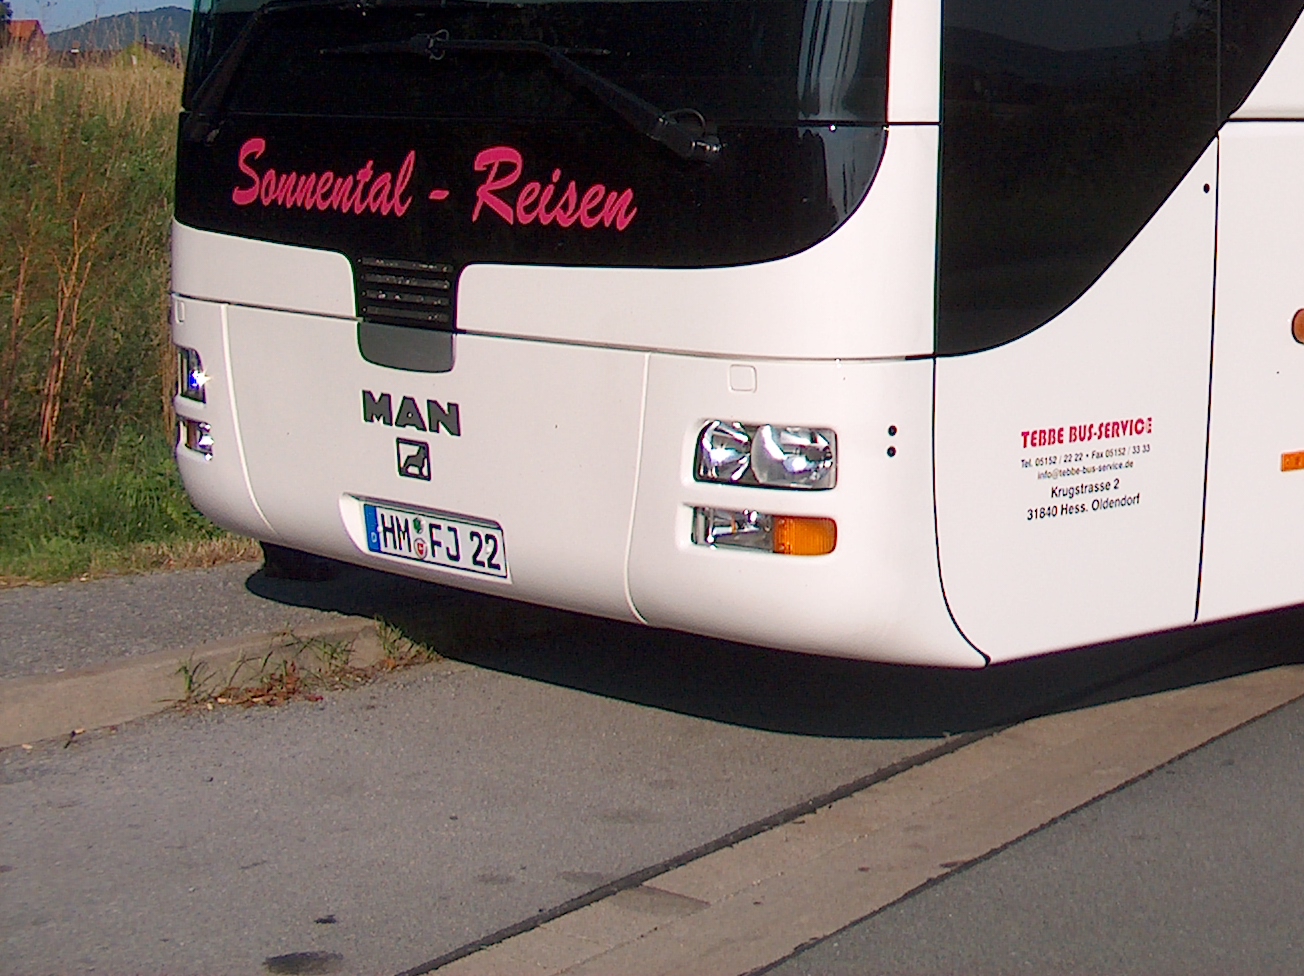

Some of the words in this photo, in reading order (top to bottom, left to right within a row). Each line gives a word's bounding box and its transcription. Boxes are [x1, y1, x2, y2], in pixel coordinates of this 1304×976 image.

[232, 137, 416, 218] Sonnental
[471, 145, 638, 232] Reisen
[361, 389, 461, 437] MAN
[1021, 427, 1064, 449] TEBBE
[1035, 455, 1058, 467] 05152
[1051, 483, 1111, 499] Krugstrasse
[1113, 478, 1120, 490] 2
[1027, 505, 1058, 521] 31840
[1060, 502, 1088, 516] Hess.
[1091, 493, 1141, 512] Oldendorf
[380, 513, 412, 553] HM
[428, 523, 461, 562] FJ
[469, 531, 501, 571] 22
